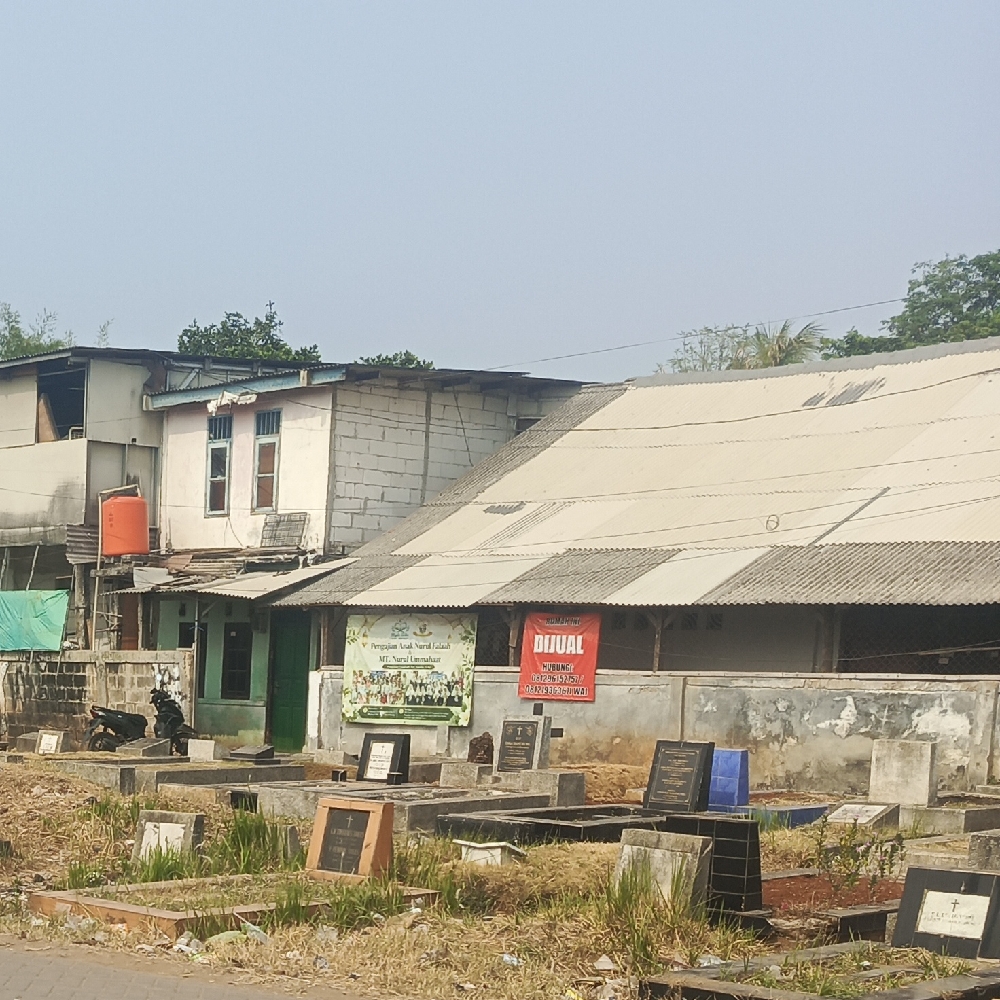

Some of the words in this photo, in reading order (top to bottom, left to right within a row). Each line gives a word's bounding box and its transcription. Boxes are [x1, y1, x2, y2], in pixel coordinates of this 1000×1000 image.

[545, 617, 570, 625] RUMAH
[571, 617, 581, 626] INI
[371, 642, 397, 651] Pengajian
[533, 634, 584, 654] DIJUAL
[392, 655, 409, 663] Nurul
